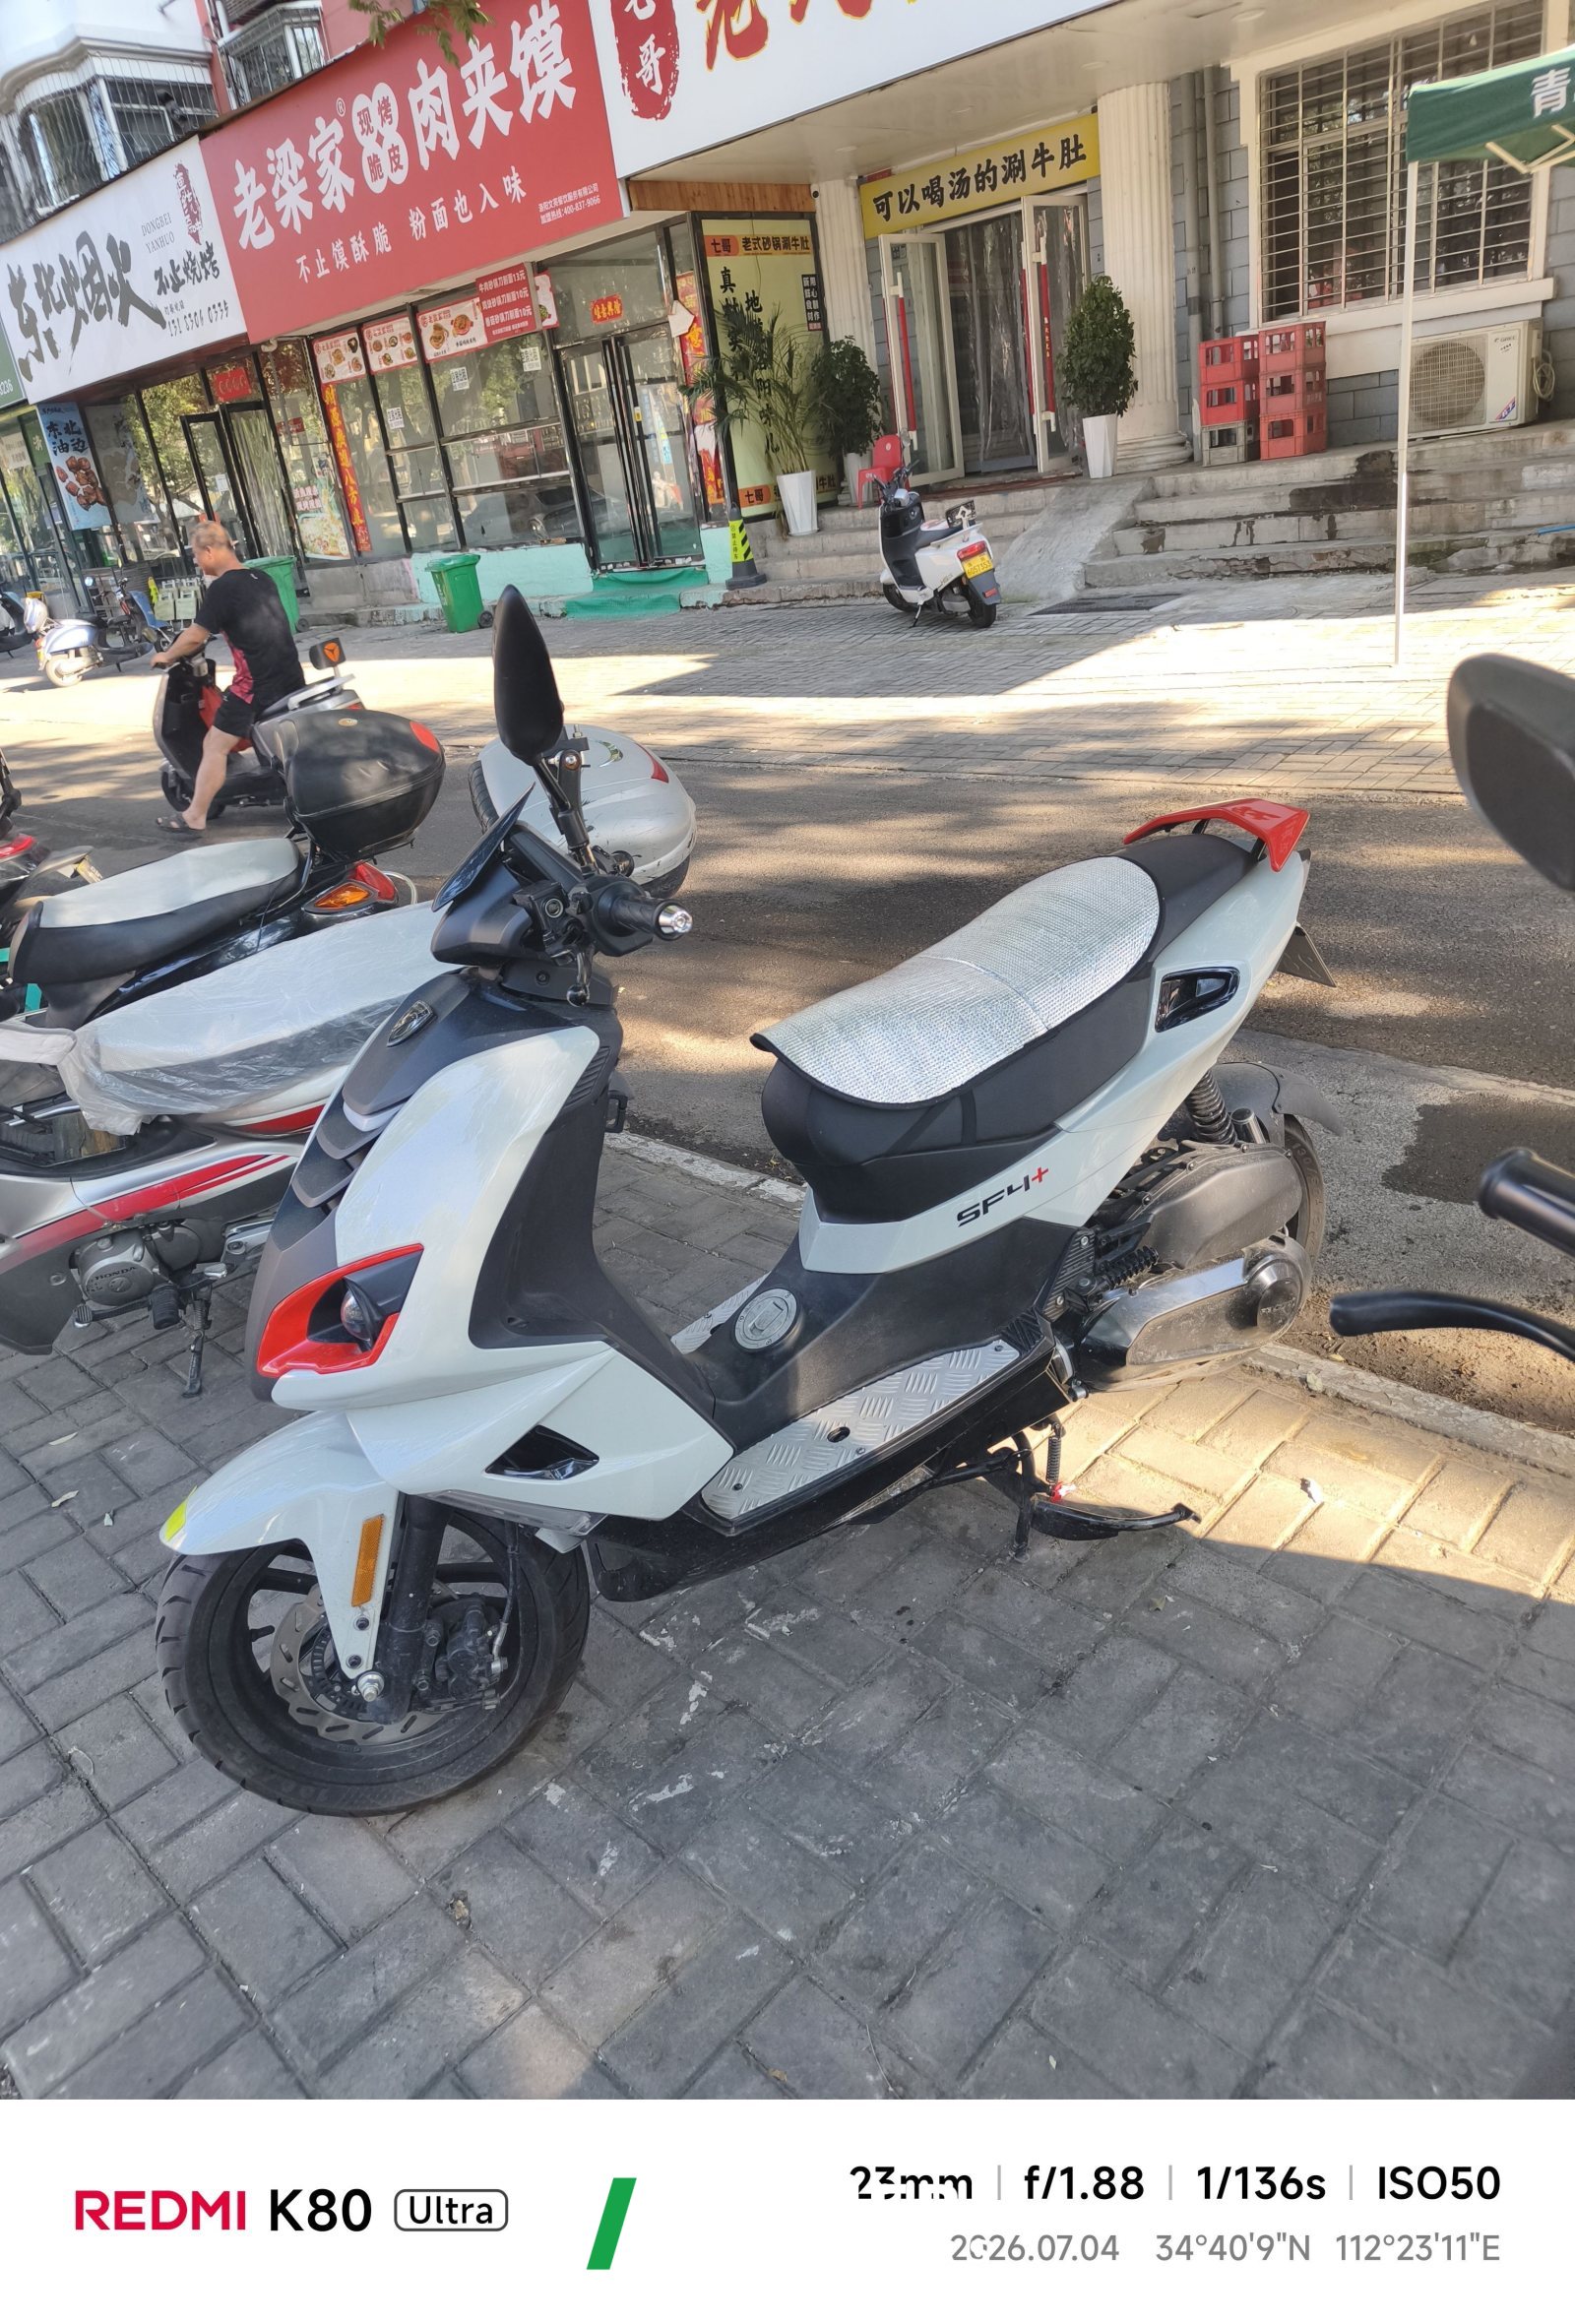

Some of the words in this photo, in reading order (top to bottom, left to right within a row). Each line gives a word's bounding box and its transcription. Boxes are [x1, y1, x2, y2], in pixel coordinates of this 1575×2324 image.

[1530, 67, 1575, 118] 青
[233, 116, 354, 250] 老梁家
[409, 1, 577, 170] 肉夹馍
[356, 96, 394, 137] 现烤
[366, 144, 404, 184] 脆皮
[872, 134, 1087, 221] 可以喝汤的涮牛肚
[141, 212, 172, 236] DONGBEI
[146, 230, 175, 254] YANHUO
[296, 221, 392, 283] 不止馍酥脆
[409, 165, 527, 240] 粉面也入味
[711, 237, 731, 253] 七哥
[741, 236, 810, 251] 老式砂锅涮牛肚
[155, 240, 220, 295] 不止烧烤
[46, 419, 82, 438] 东北
[744, 488, 764, 503] 七哥
[94, 1266, 137, 1281] HONDA
